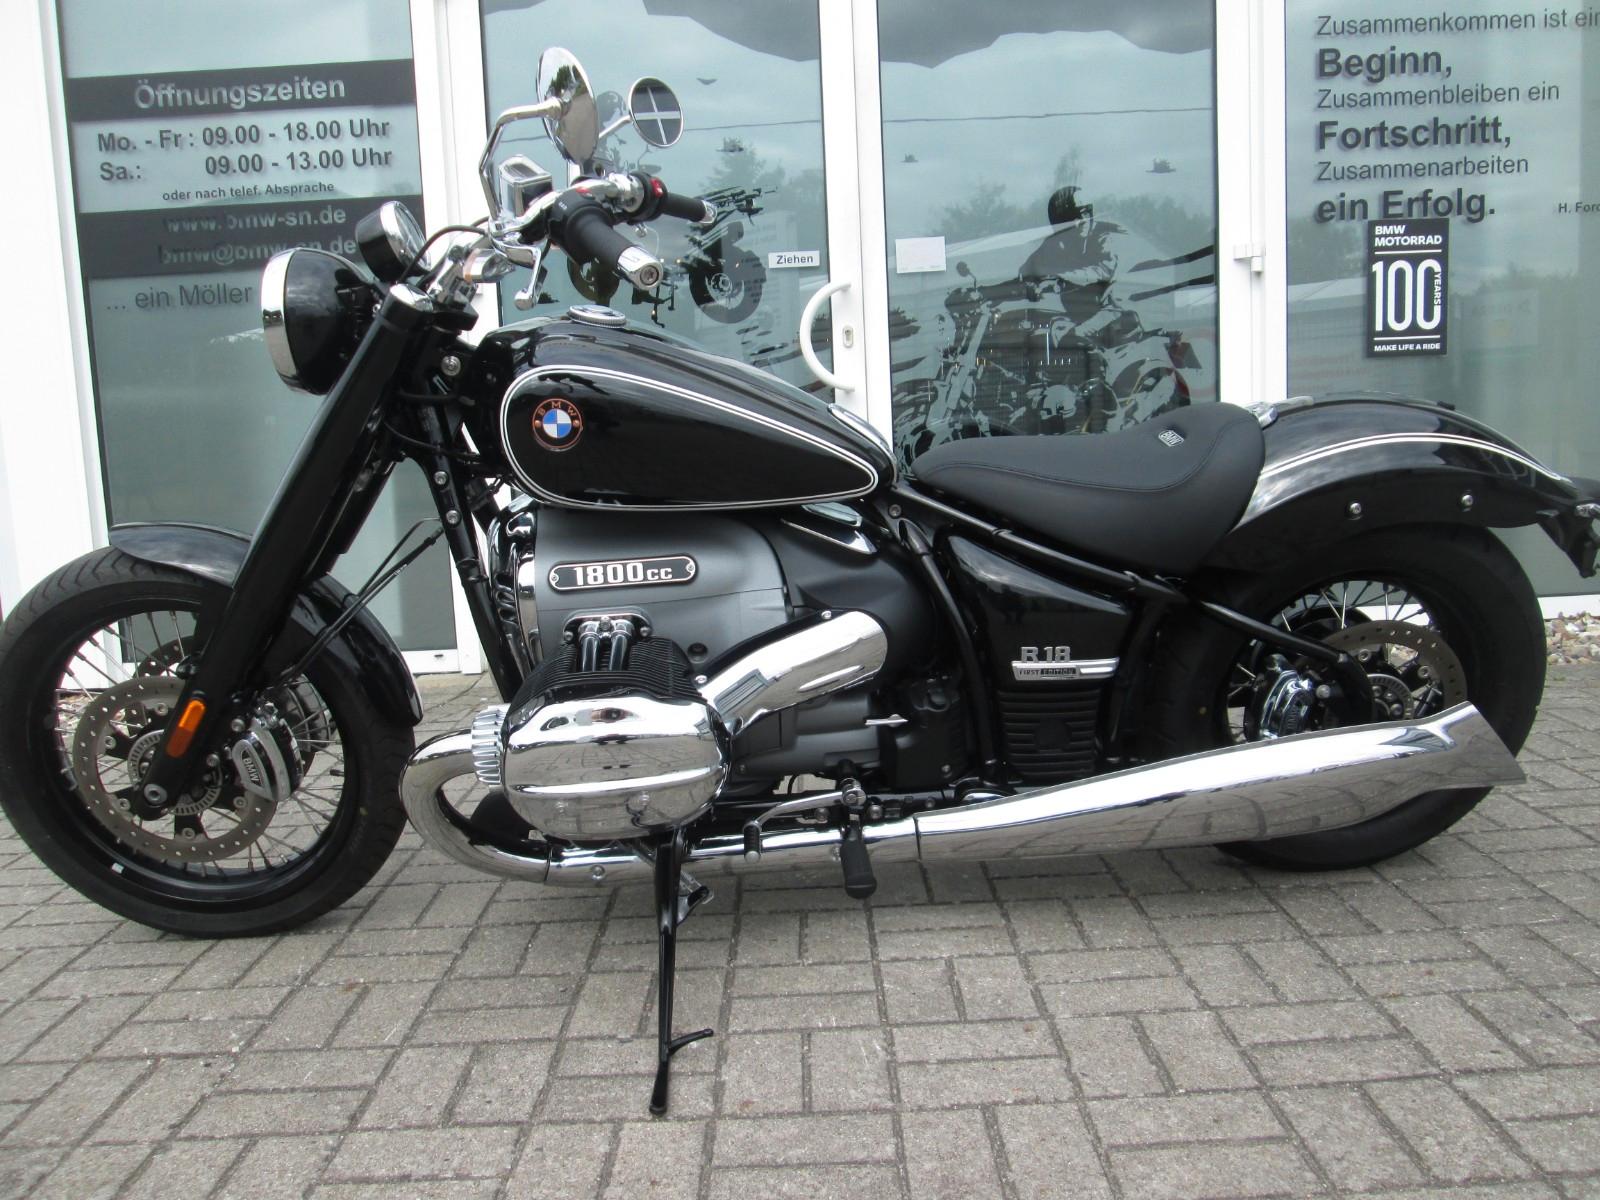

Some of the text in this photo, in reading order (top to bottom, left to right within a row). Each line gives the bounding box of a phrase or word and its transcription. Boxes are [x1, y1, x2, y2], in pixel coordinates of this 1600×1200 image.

[1316, 12, 1536, 36] Zusammenkommen
[1543, 8, 1567, 28] ist
[1318, 45, 1452, 83] Beginn,
[134, 76, 346, 110] Öffnungszeiten
[1317, 81, 1560, 109] Zusammenbleiben ein
[97, 132, 137, 152] Mo.
[202, 124, 260, 146] 09.00
[284, 120, 341, 143] 18.00
[349, 118, 390, 139] Uhr
[1319, 115, 1511, 149] Fortschritt,
[205, 154, 263, 175] 09.00
[287, 150, 344, 172] 13.00
[352, 147, 393, 167] Uhr
[1317, 155, 1529, 181] Zusammenarbeiten
[162, 189, 191, 201] oder
[195, 186, 226, 199] nach
[265, 181, 335, 196] Absprache
[1316, 188, 1496, 223] ein Erfolg.
[1374, 235, 1442, 247] MOTORRAD
[1375, 225, 1406, 235] BMW
[776, 254, 814, 265] Ziehen
[135, 290, 171, 310] ein
[179, 284, 253, 307] Möller
[1372, 258, 1442, 332] 100
[1434, 272, 1442, 305] YEARS
[573, 562, 673, 586] 1800cc
[1021, 646, 1071, 663] R 18
